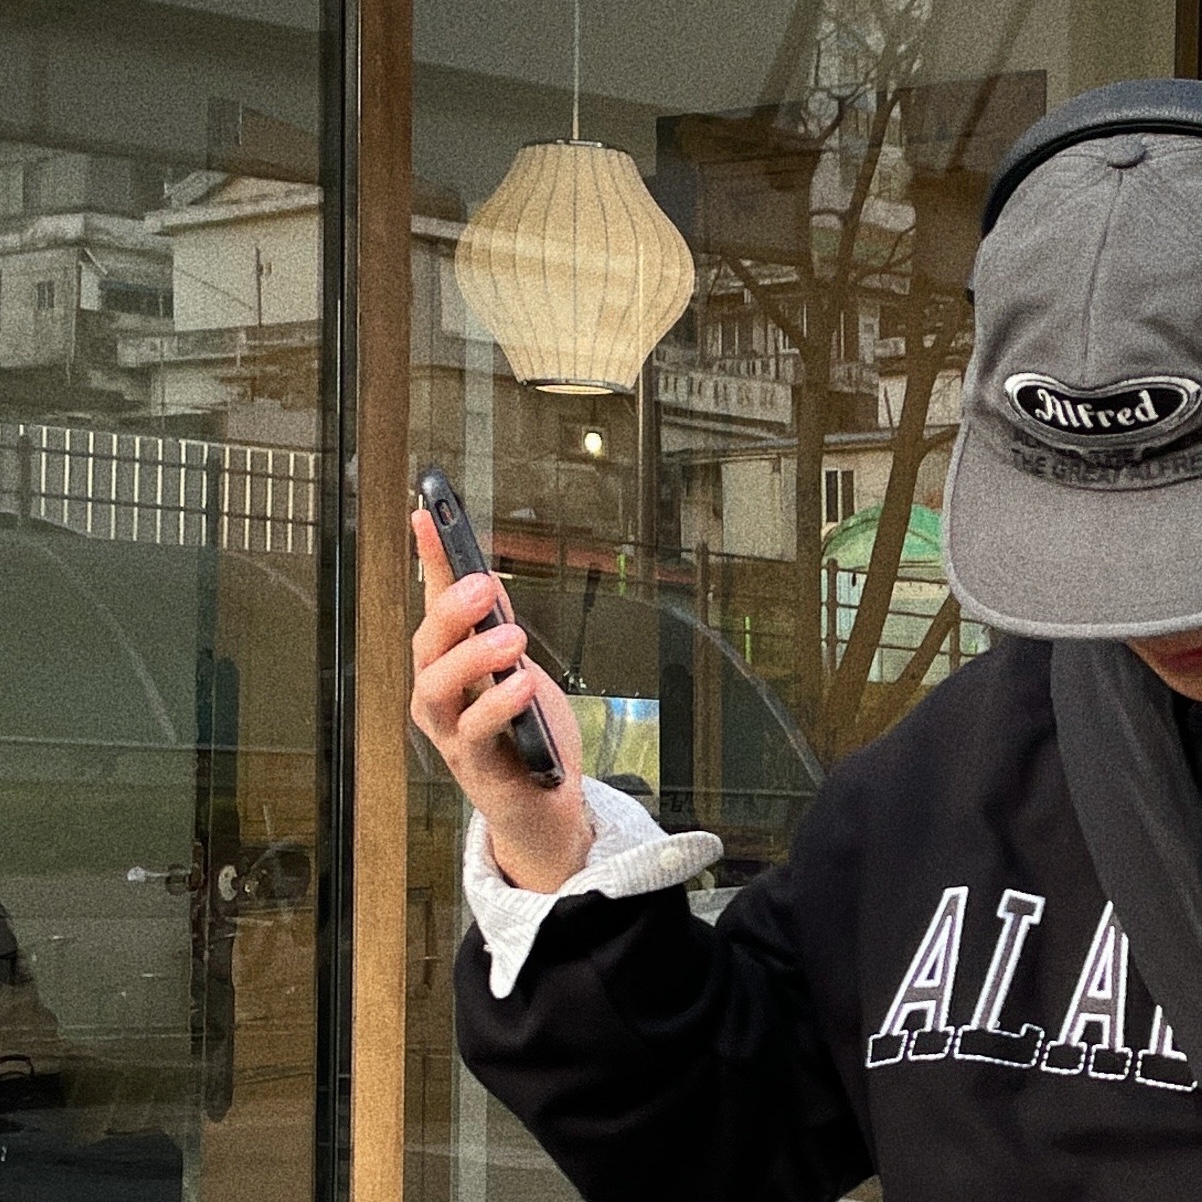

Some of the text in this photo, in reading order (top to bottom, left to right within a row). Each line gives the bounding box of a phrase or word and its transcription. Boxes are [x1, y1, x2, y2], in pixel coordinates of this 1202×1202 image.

[1034, 388, 1160, 429] Alfred
[1011, 447, 1047, 476] THE
[1052, 460, 1122, 485] GREAT
